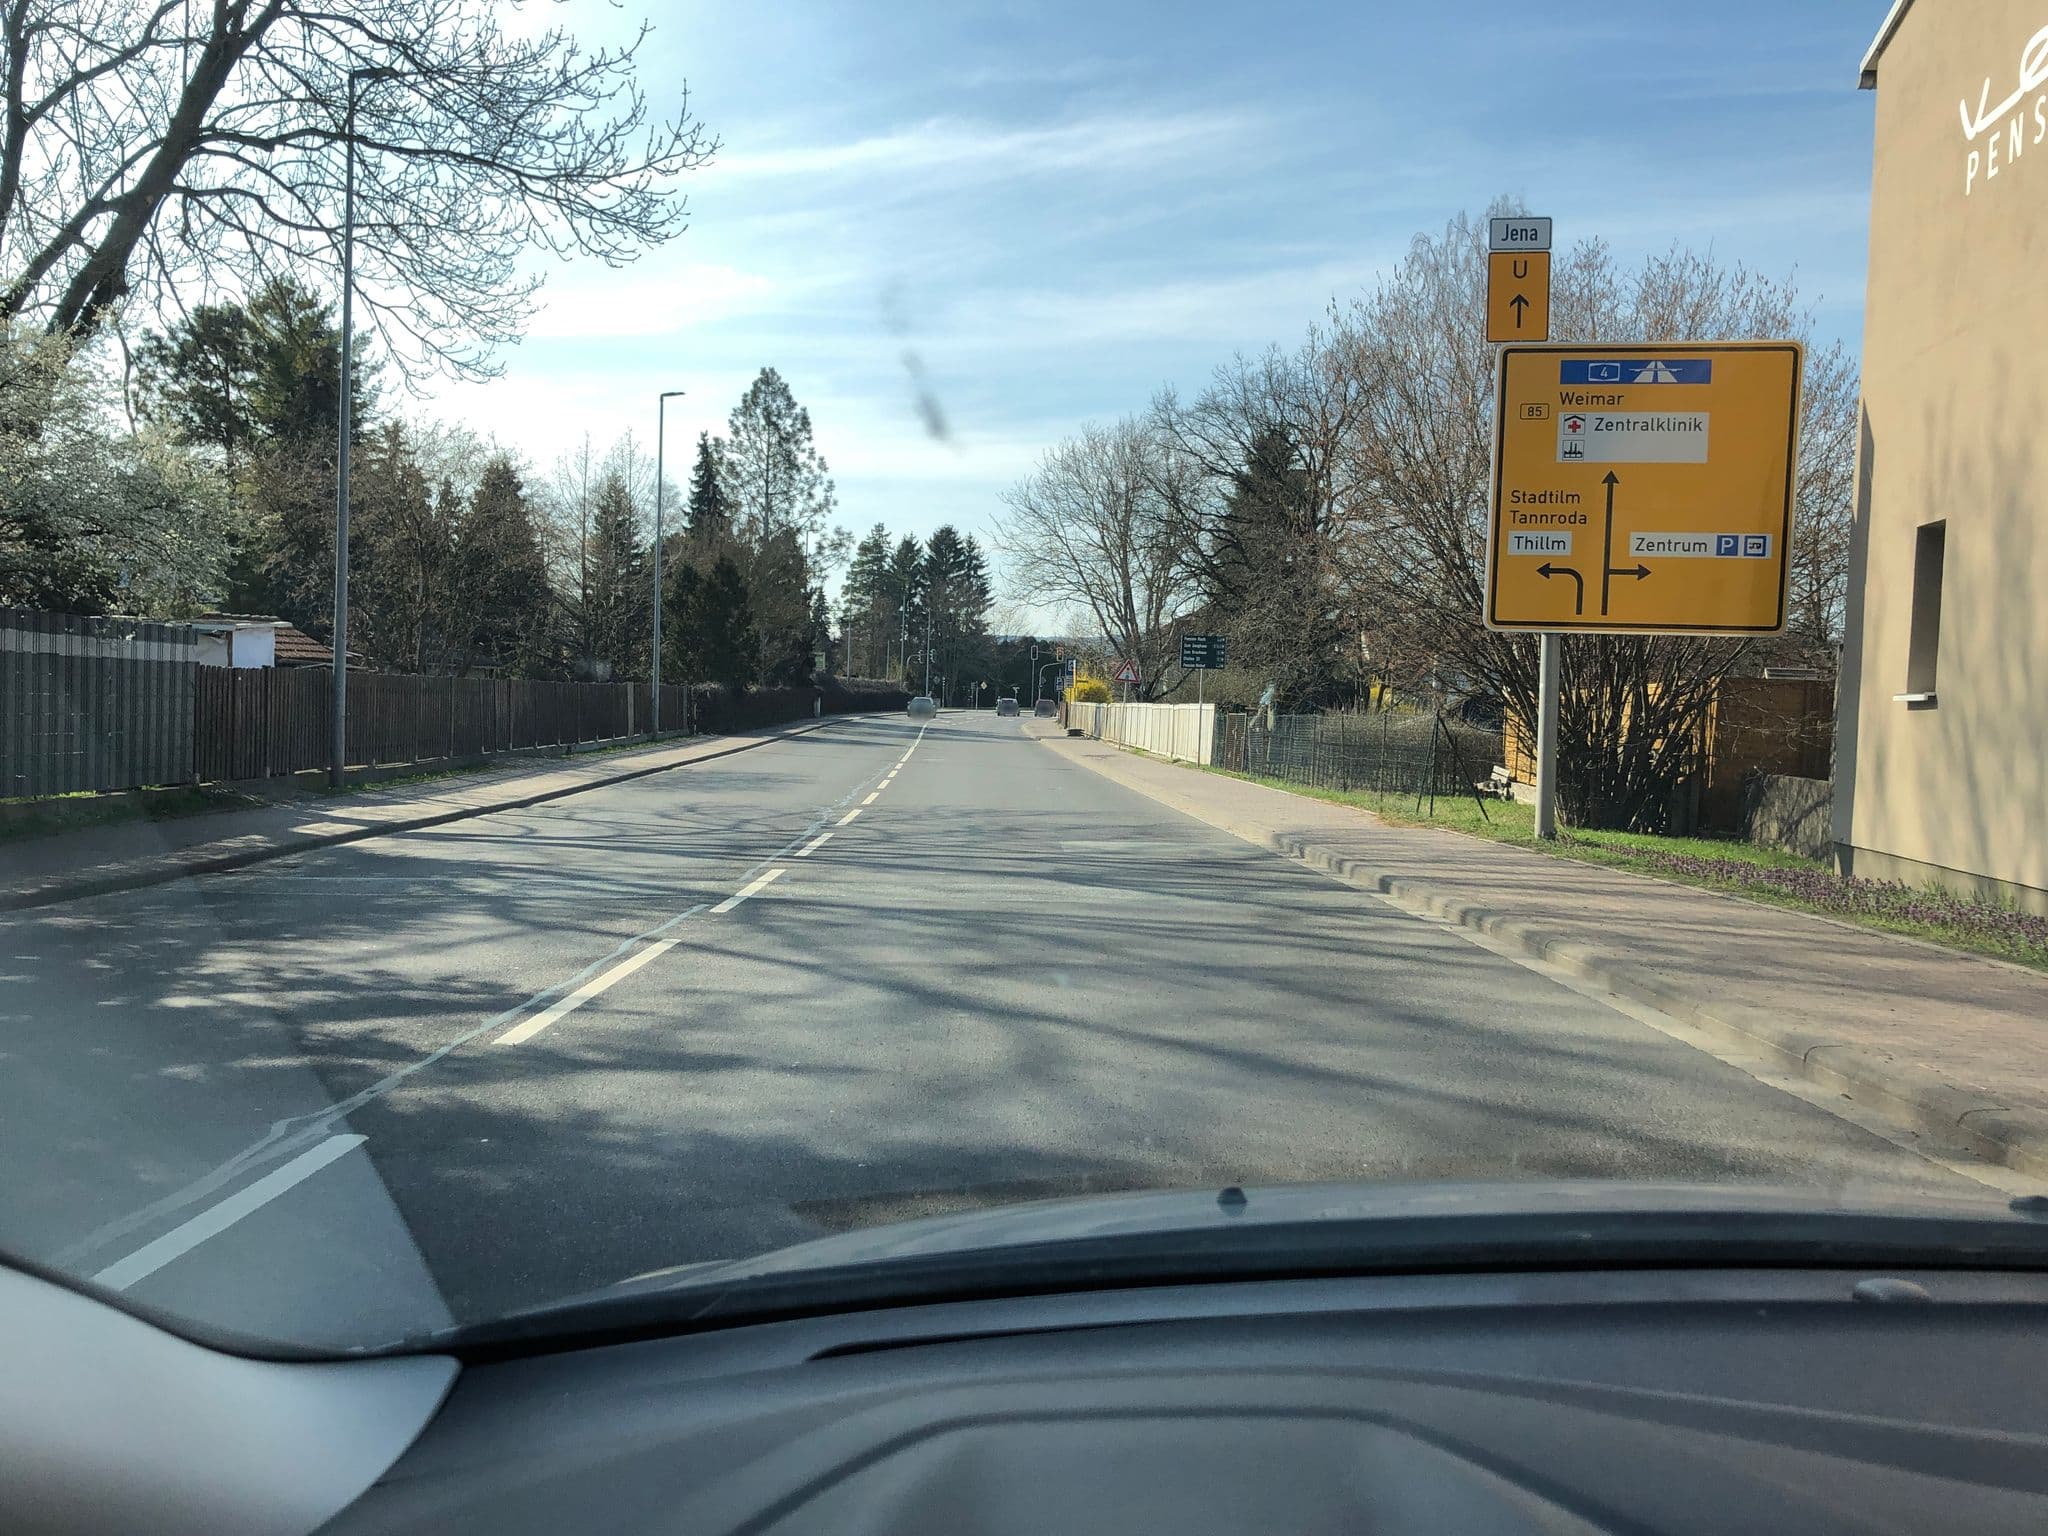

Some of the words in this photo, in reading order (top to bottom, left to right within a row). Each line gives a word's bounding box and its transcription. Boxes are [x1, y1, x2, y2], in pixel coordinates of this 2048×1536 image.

[1501, 224, 1538, 242] Jena
[1513, 260, 1528, 279] U
[1600, 366, 1608, 378] 4
[1559, 391, 1625, 406] Weimar
[1527, 406, 1542, 418] 85
[1594, 417, 1703, 432] Zentralklinik
[1510, 490, 1580, 504] Stadtilm
[1510, 510, 1587, 525] Tannroda
[1514, 535, 1566, 550] Thillm
[1635, 537, 1708, 553] Zentrum
[1721, 538, 1733, 553] P
